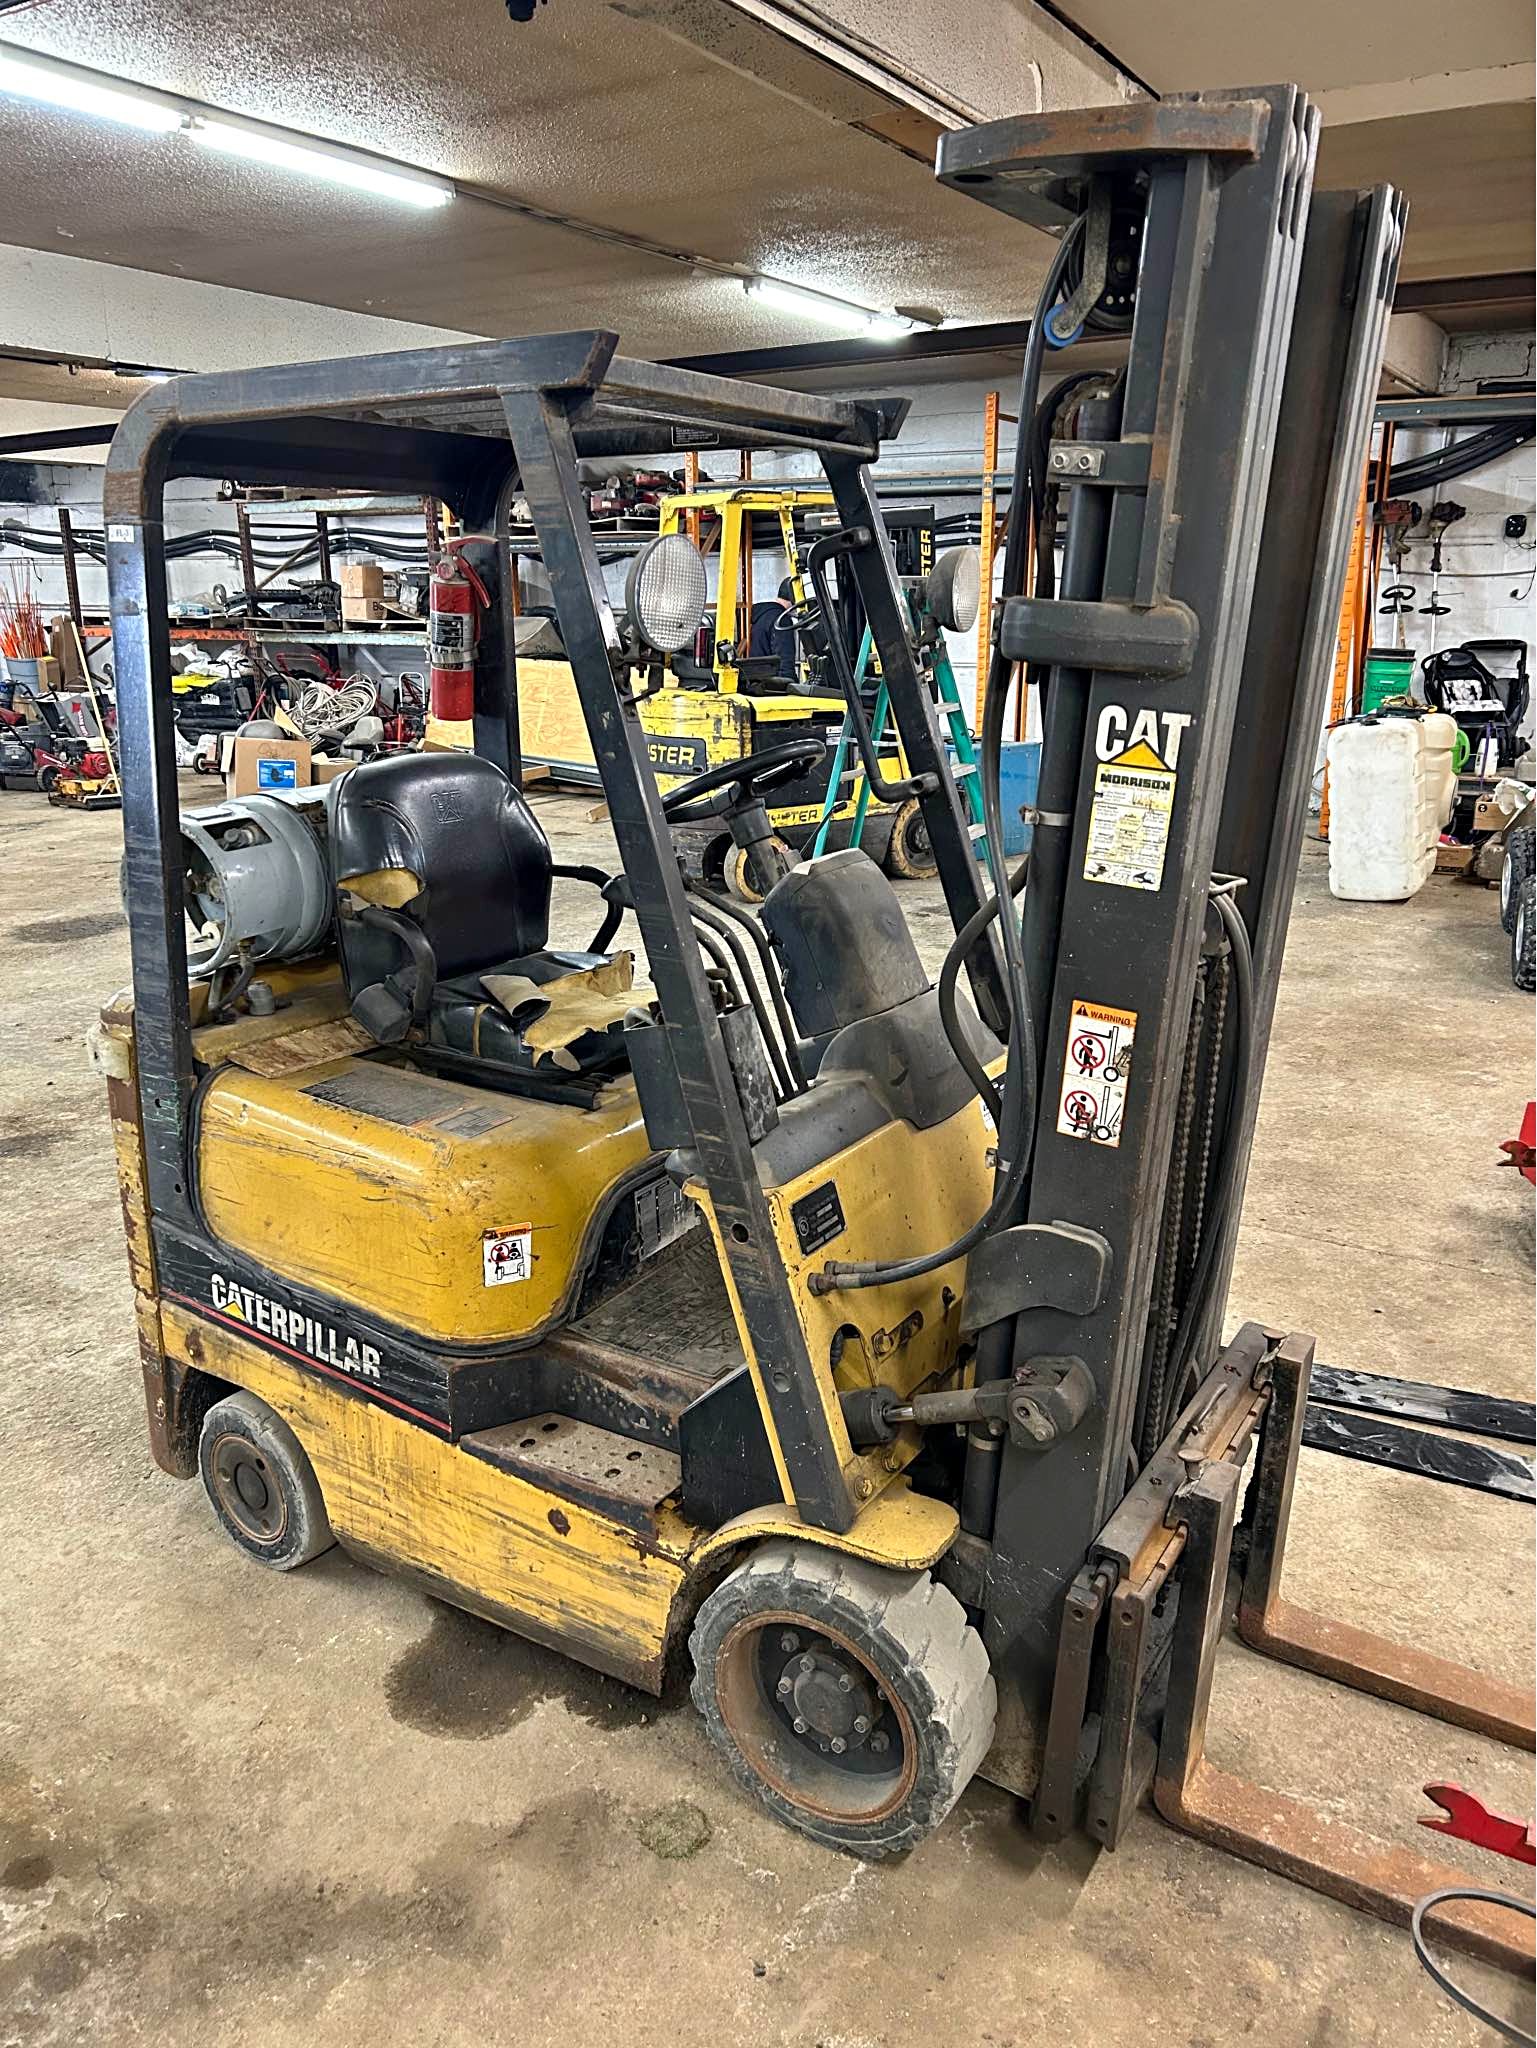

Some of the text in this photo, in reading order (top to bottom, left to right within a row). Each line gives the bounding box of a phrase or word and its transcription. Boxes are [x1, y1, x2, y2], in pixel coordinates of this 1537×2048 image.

[1095, 704, 1192, 771] CAT
[1100, 773, 1171, 791] MORRISON
[1090, 1010, 1131, 1026] WARNING
[210, 1273, 382, 1379] CATERPILLAR
